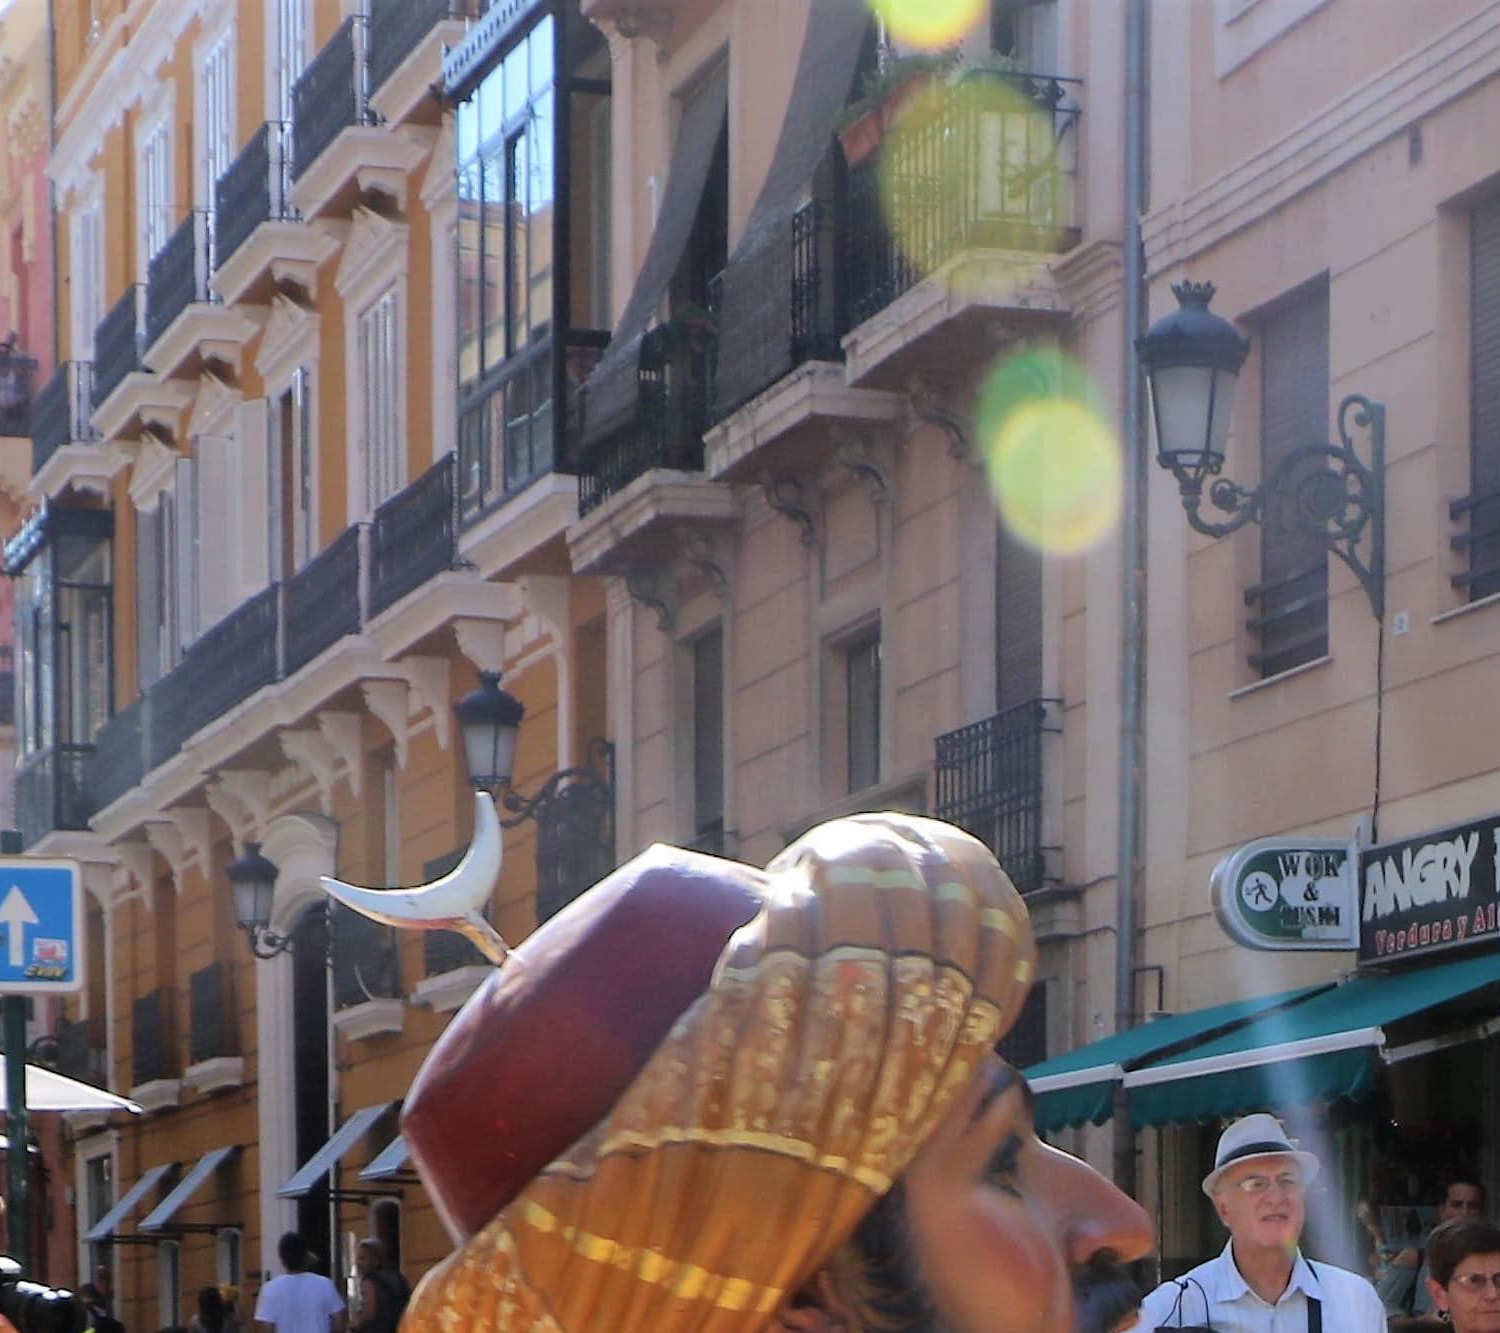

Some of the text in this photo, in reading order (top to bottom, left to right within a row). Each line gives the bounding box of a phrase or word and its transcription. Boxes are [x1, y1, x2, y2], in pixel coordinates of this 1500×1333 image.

[1278, 852, 1339, 879] WOK
[1362, 831, 1480, 922] ANGRY
[1303, 882, 1318, 902] &
[1375, 919, 1452, 955] Verdura
[1456, 914, 1469, 940] y
